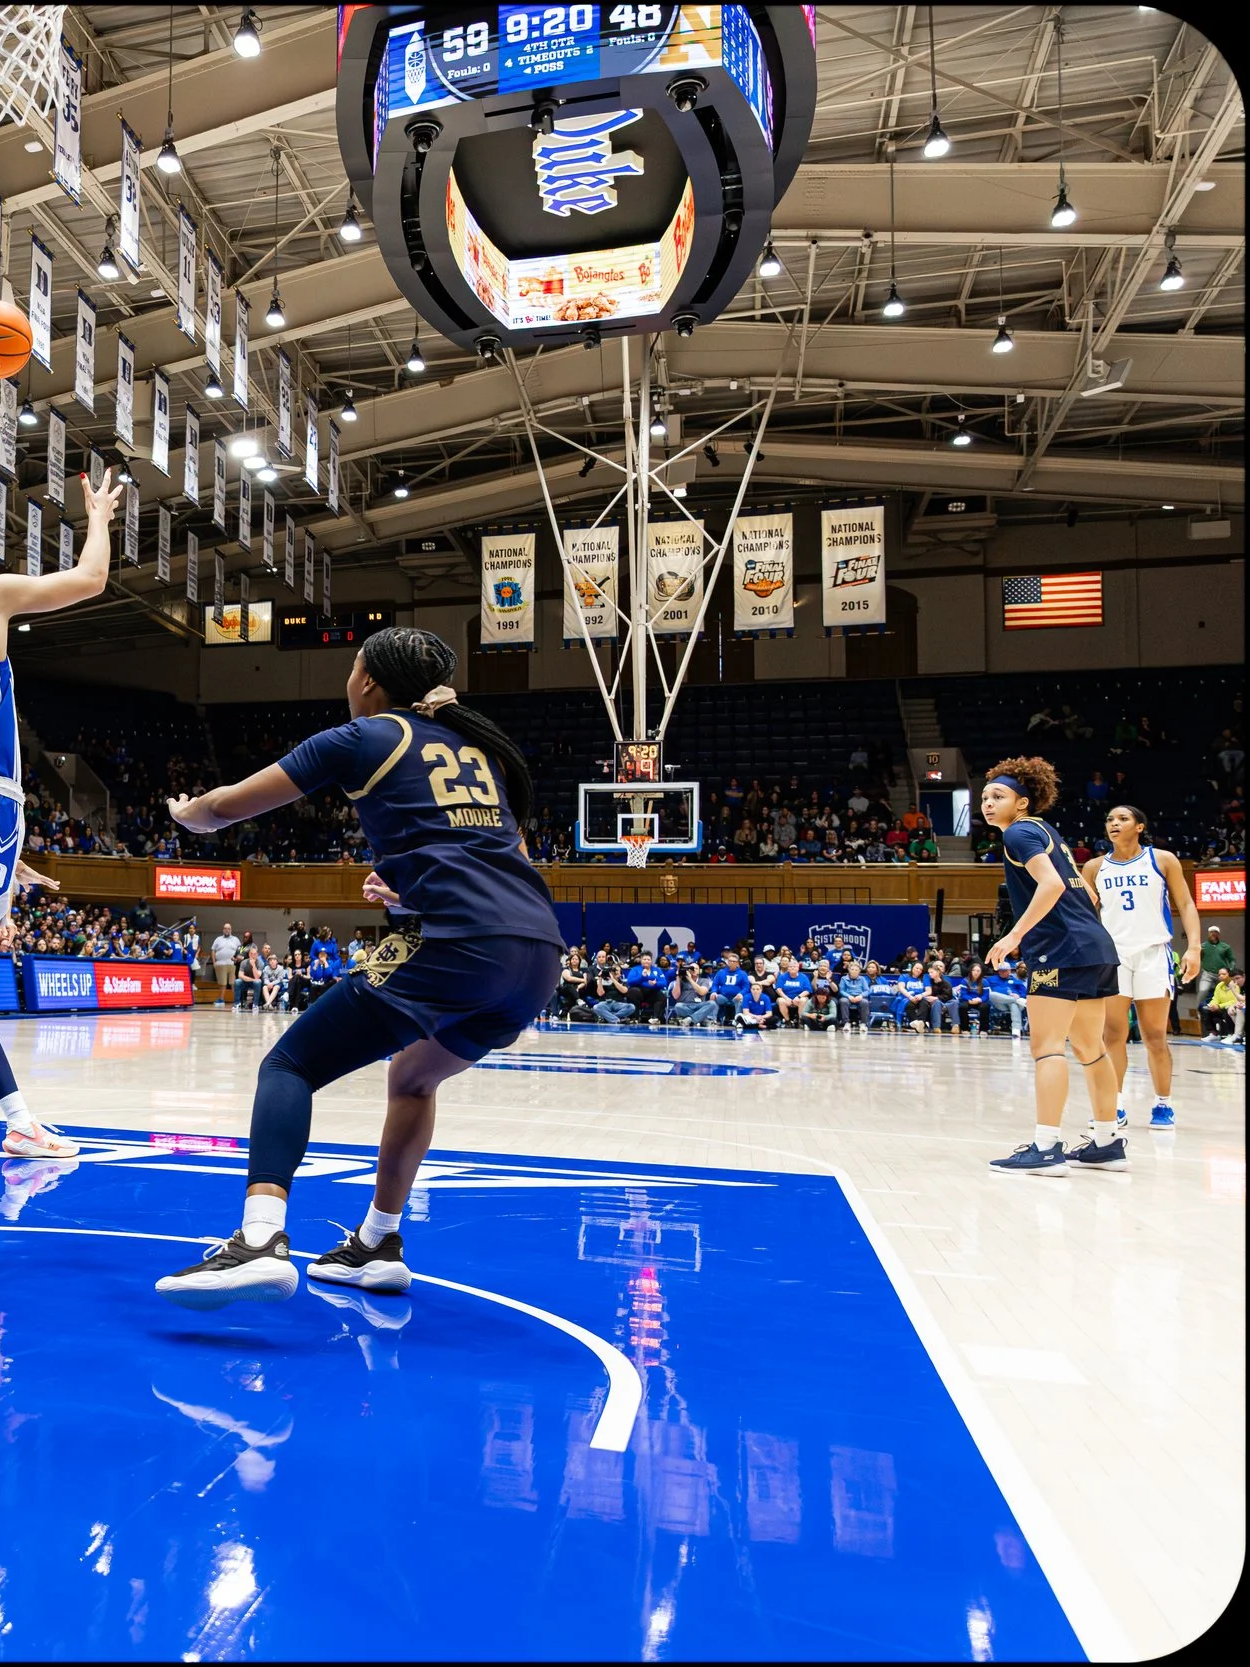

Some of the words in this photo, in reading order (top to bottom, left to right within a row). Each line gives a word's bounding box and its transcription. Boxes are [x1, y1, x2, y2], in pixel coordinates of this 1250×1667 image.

[506, 4, 593, 43] 9:20
[608, 4, 662, 31] 48
[442, 21, 489, 62] 59
[523, 39, 549, 53] 4TH
[550, 36, 575, 50] QTR
[608, 34, 645, 47] Fouls:
[504, 59, 513, 68] 4
[517, 47, 581, 66] TIMEOUTS
[447, 65, 481, 80] Fouls:
[483, 62, 491, 72] 0
[533, 60, 564, 74] POSS
[62, 94, 79, 133] 35
[573, 265, 625, 283] Bojangles
[512, 316, 524, 324] IT'S
[536, 314, 551, 323] TIME!
[741, 528, 784, 541] NATIONAL
[830, 521, 876, 535] NATIONAL
[737, 540, 790, 554] CHAMPIONS
[826, 533, 882, 547] CHAMPIONS
[489, 547, 528, 558] NATIONAL
[484, 558, 532, 570] CHAMPIONS
[751, 604, 778, 616] 2010
[841, 600, 870, 612] 2015
[284, 617, 306, 625] DUKE
[583, 615, 604, 625] 992
[663, 609, 688, 621] 2001
[496, 620, 520, 630] 1991
[628, 745, 658, 759] 9:20
[420, 742, 500, 807] 23
[446, 808, 502, 828] MOORE
[160, 874, 182, 886] FAN
[183, 875, 217, 887] WORK
[1104, 874, 1148, 890] DUKE
[1201, 881, 1232, 894] FAN
[1120, 890, 1136, 911] 3
[1202, 893, 1212, 902] IS
[38, 972, 78, 997] WHEELS
[79, 973, 92, 996] UP
